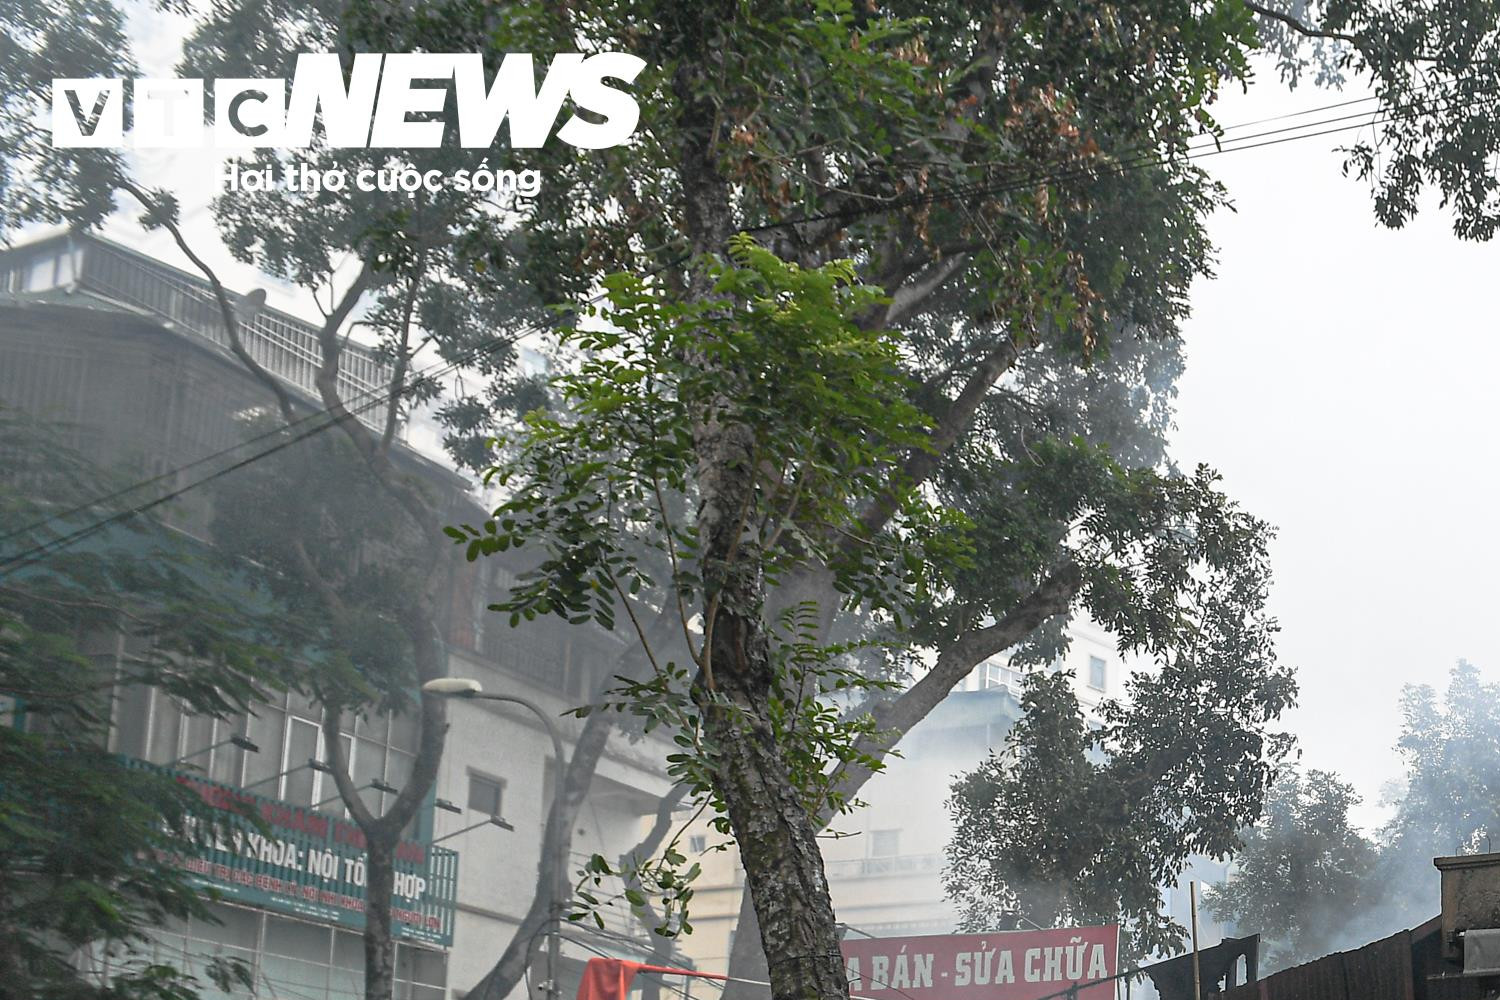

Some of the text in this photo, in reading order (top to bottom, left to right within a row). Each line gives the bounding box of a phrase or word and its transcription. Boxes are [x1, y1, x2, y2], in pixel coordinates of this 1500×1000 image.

[308, 848, 339, 883] NỘI
[344, 852, 368, 888] TỔ
[393, 872, 426, 903] HỢP
[871, 945, 934, 990] BÁN
[955, 941, 1015, 987] SỬA
[1024, 936, 1108, 983] CHỮA
